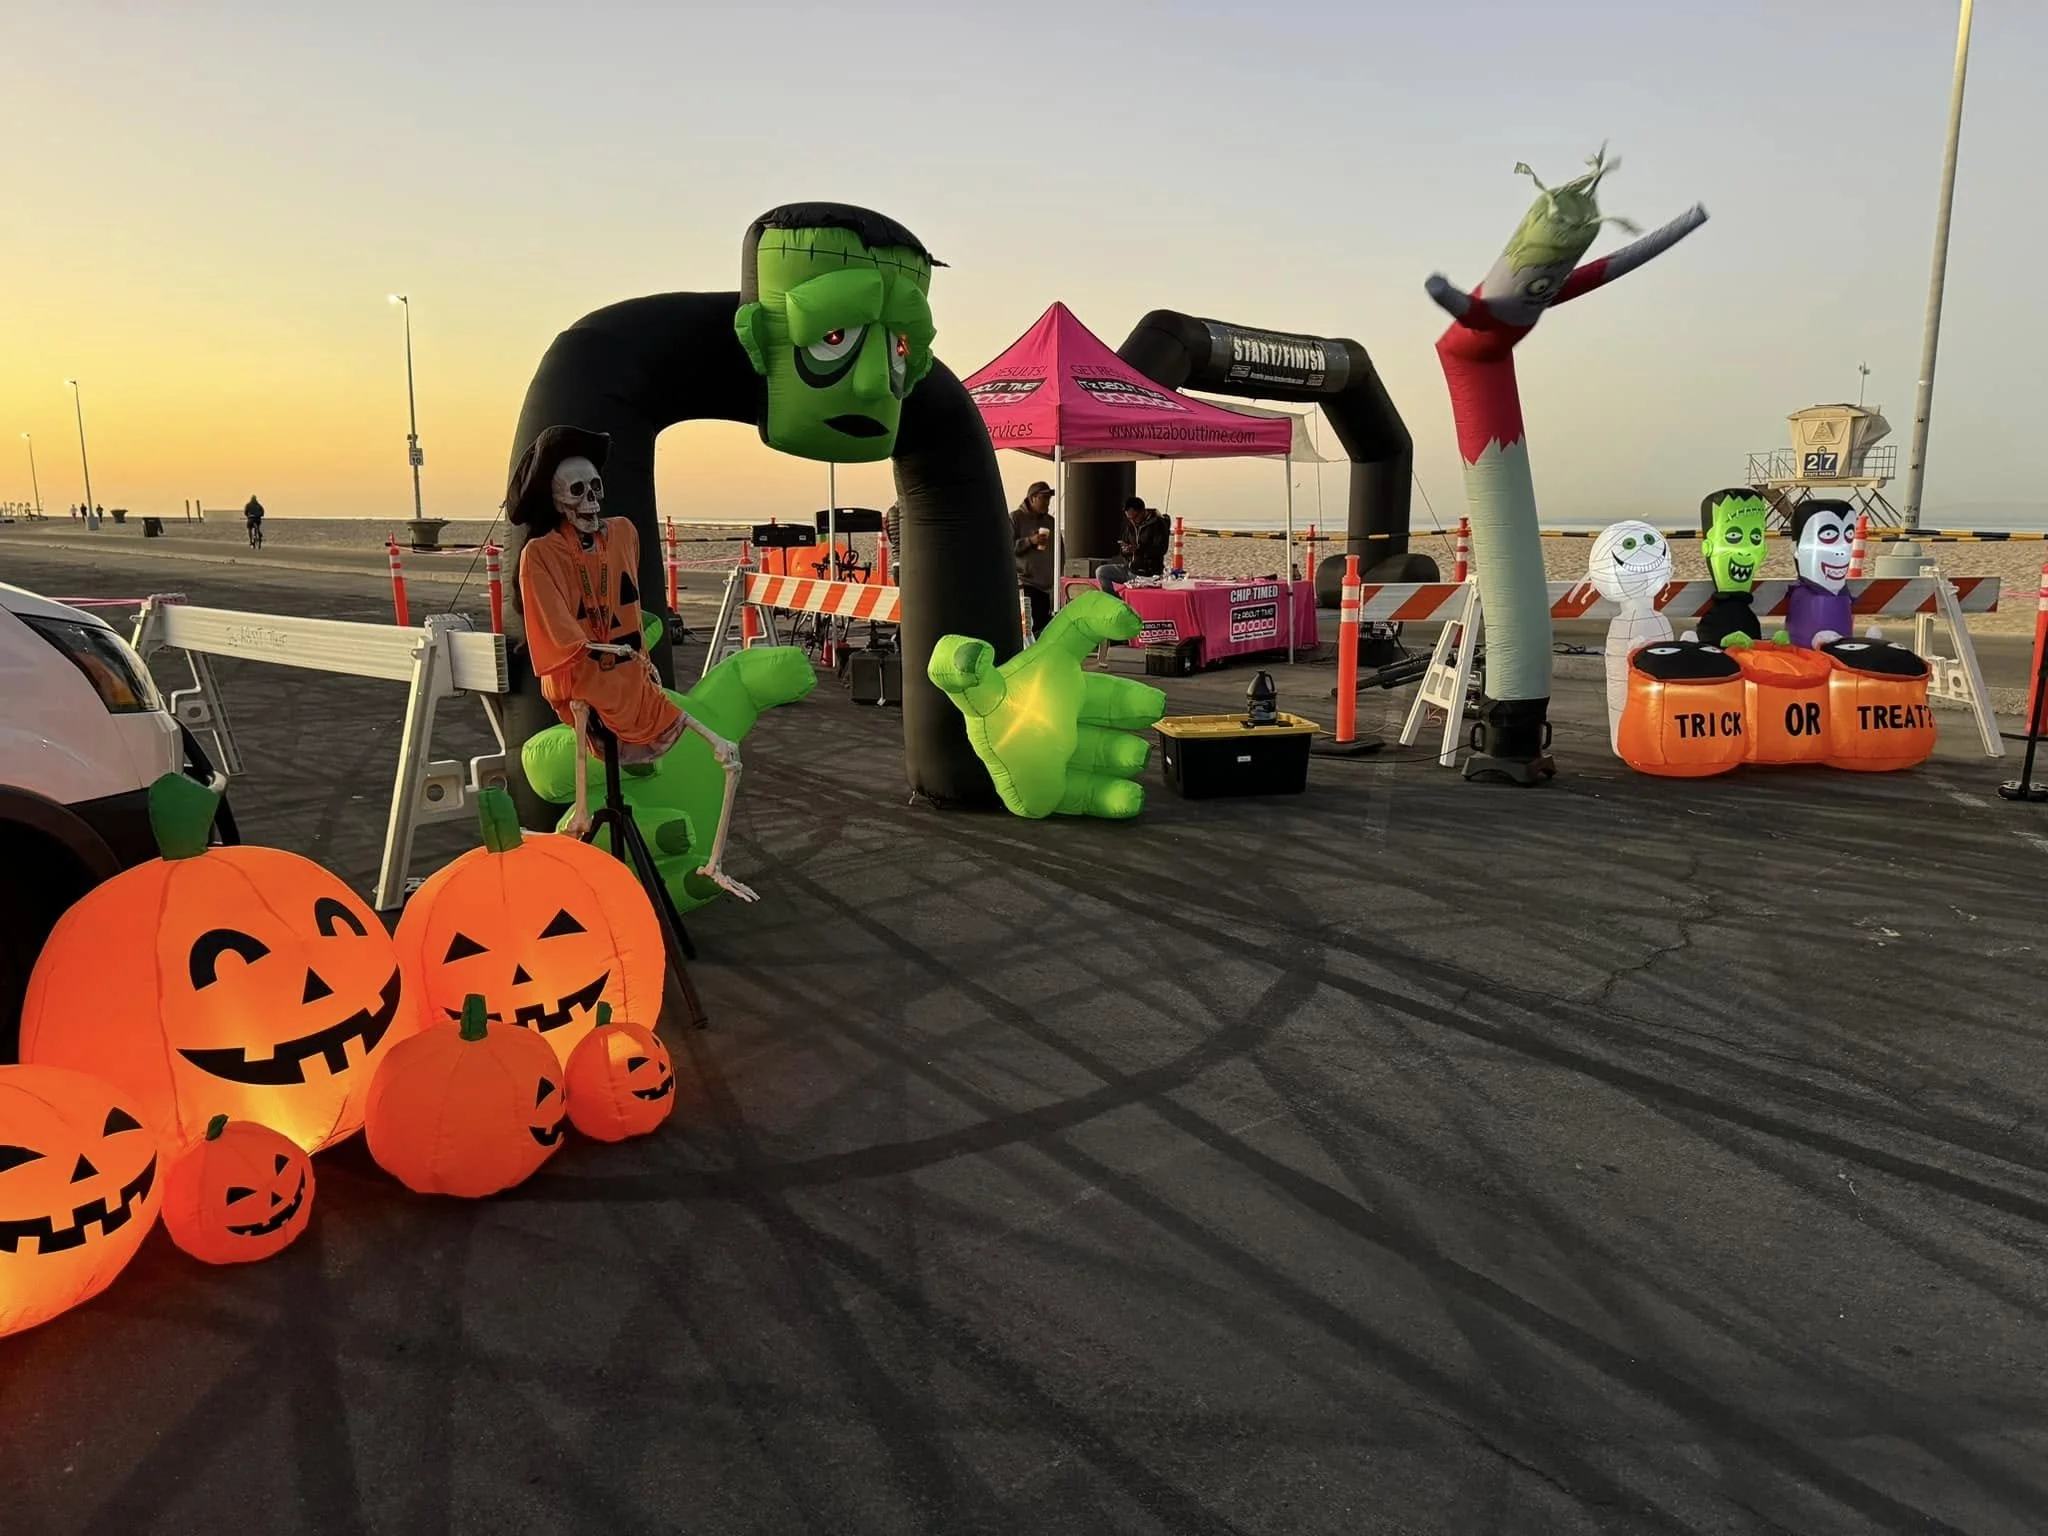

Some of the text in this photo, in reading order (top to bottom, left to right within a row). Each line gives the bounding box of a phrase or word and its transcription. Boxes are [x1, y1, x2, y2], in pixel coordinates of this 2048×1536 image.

[1233, 336, 1326, 371] START/FINISH
[988, 420, 1033, 438] ervices
[1109, 423, 1256, 444] www.itzabouttime.com
[1806, 454, 1836, 470] 27
[1230, 584, 1278, 603] CHIP TIMED
[1674, 702, 1935, 738] TRICK OR TREAT?
